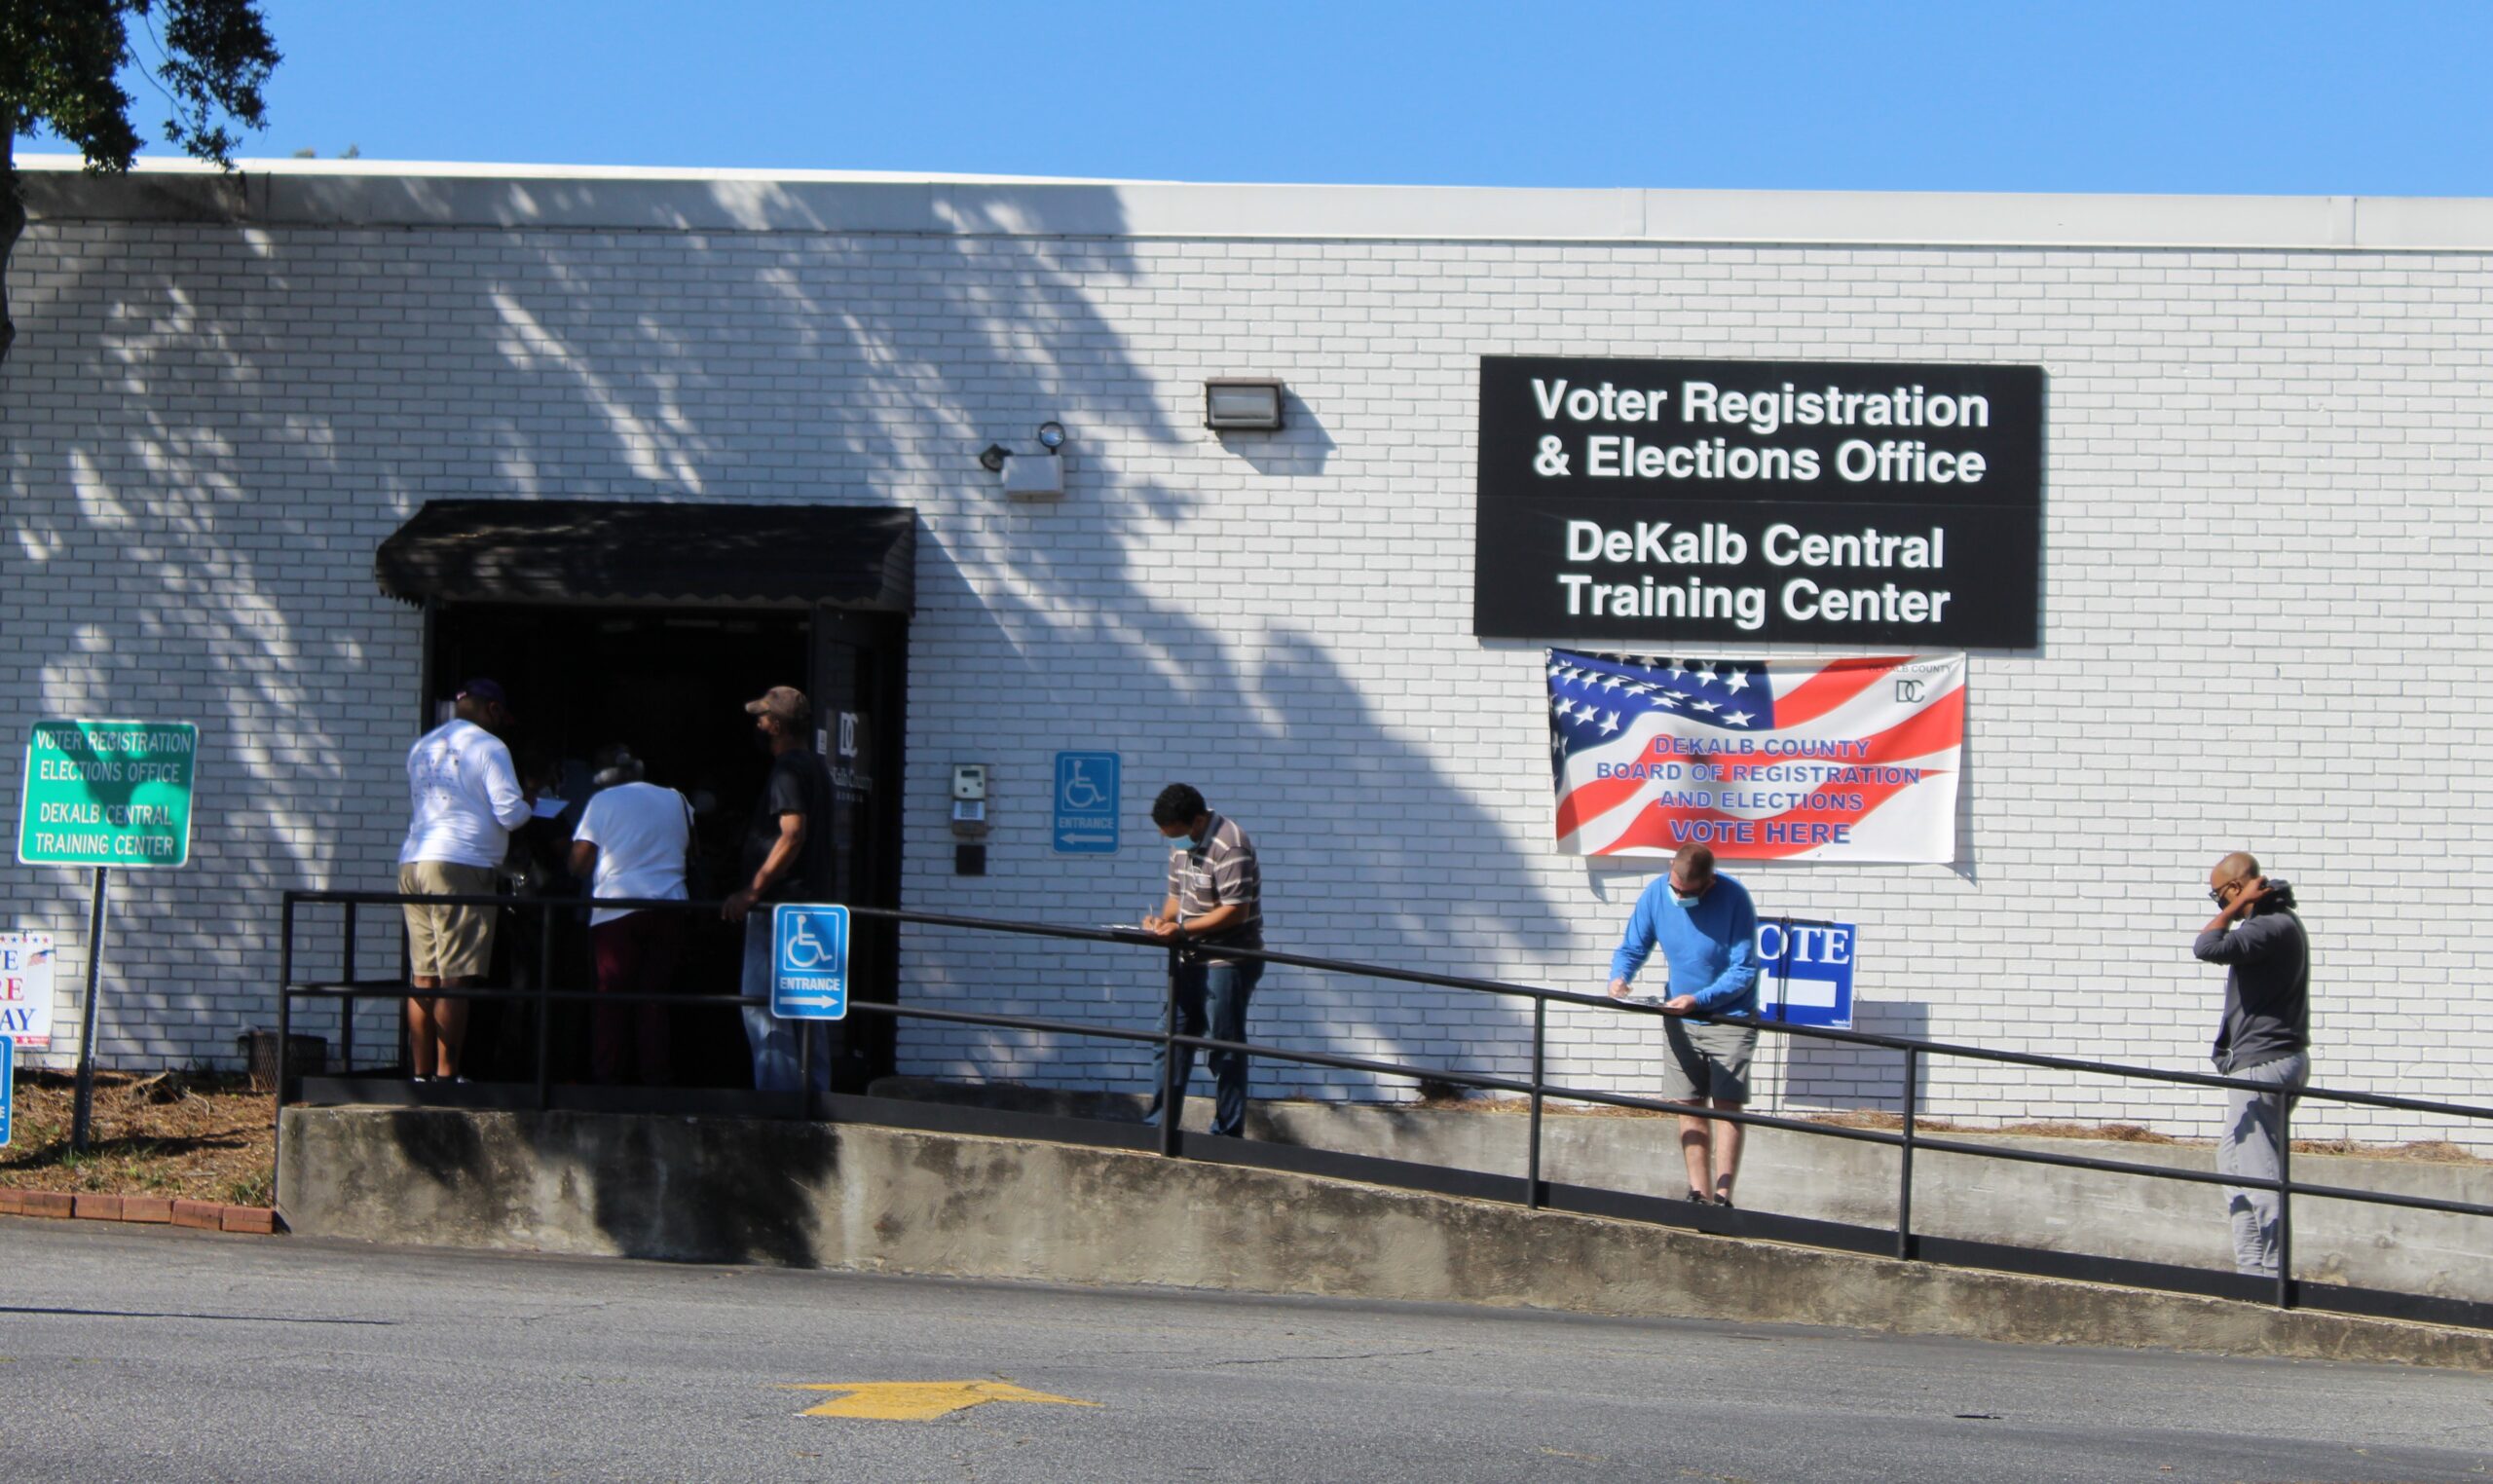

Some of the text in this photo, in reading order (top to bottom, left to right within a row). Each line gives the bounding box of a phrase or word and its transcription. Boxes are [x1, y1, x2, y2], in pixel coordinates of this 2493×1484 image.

[1532, 379, 1990, 434] Voter Registration
[1533, 434, 1987, 483] & Elections Office
[1567, 520, 1944, 568] DeKalb Central
[1558, 574, 1952, 629] Training Center
[1912, 664, 1952, 673] COUNTY
[36, 730, 191, 753] VOTER REGISTRATION
[1654, 737, 1871, 758] DEKALB COUNTY
[40, 761, 180, 783] ELECTIONS OFFICE
[1596, 762, 1920, 785] BOARD OF REGISTRATION
[1659, 791, 1865, 811] AND ELECTIONS
[40, 802, 172, 825] DEKALB CENTRAL
[1059, 816, 1114, 829] ENTRANCE
[1668, 819, 1850, 844] VOTE HERE
[35, 834, 173, 855] TRAINING CENTER
[1757, 924, 1849, 964] OTE
[779, 977, 840, 991] ENTRANCE
